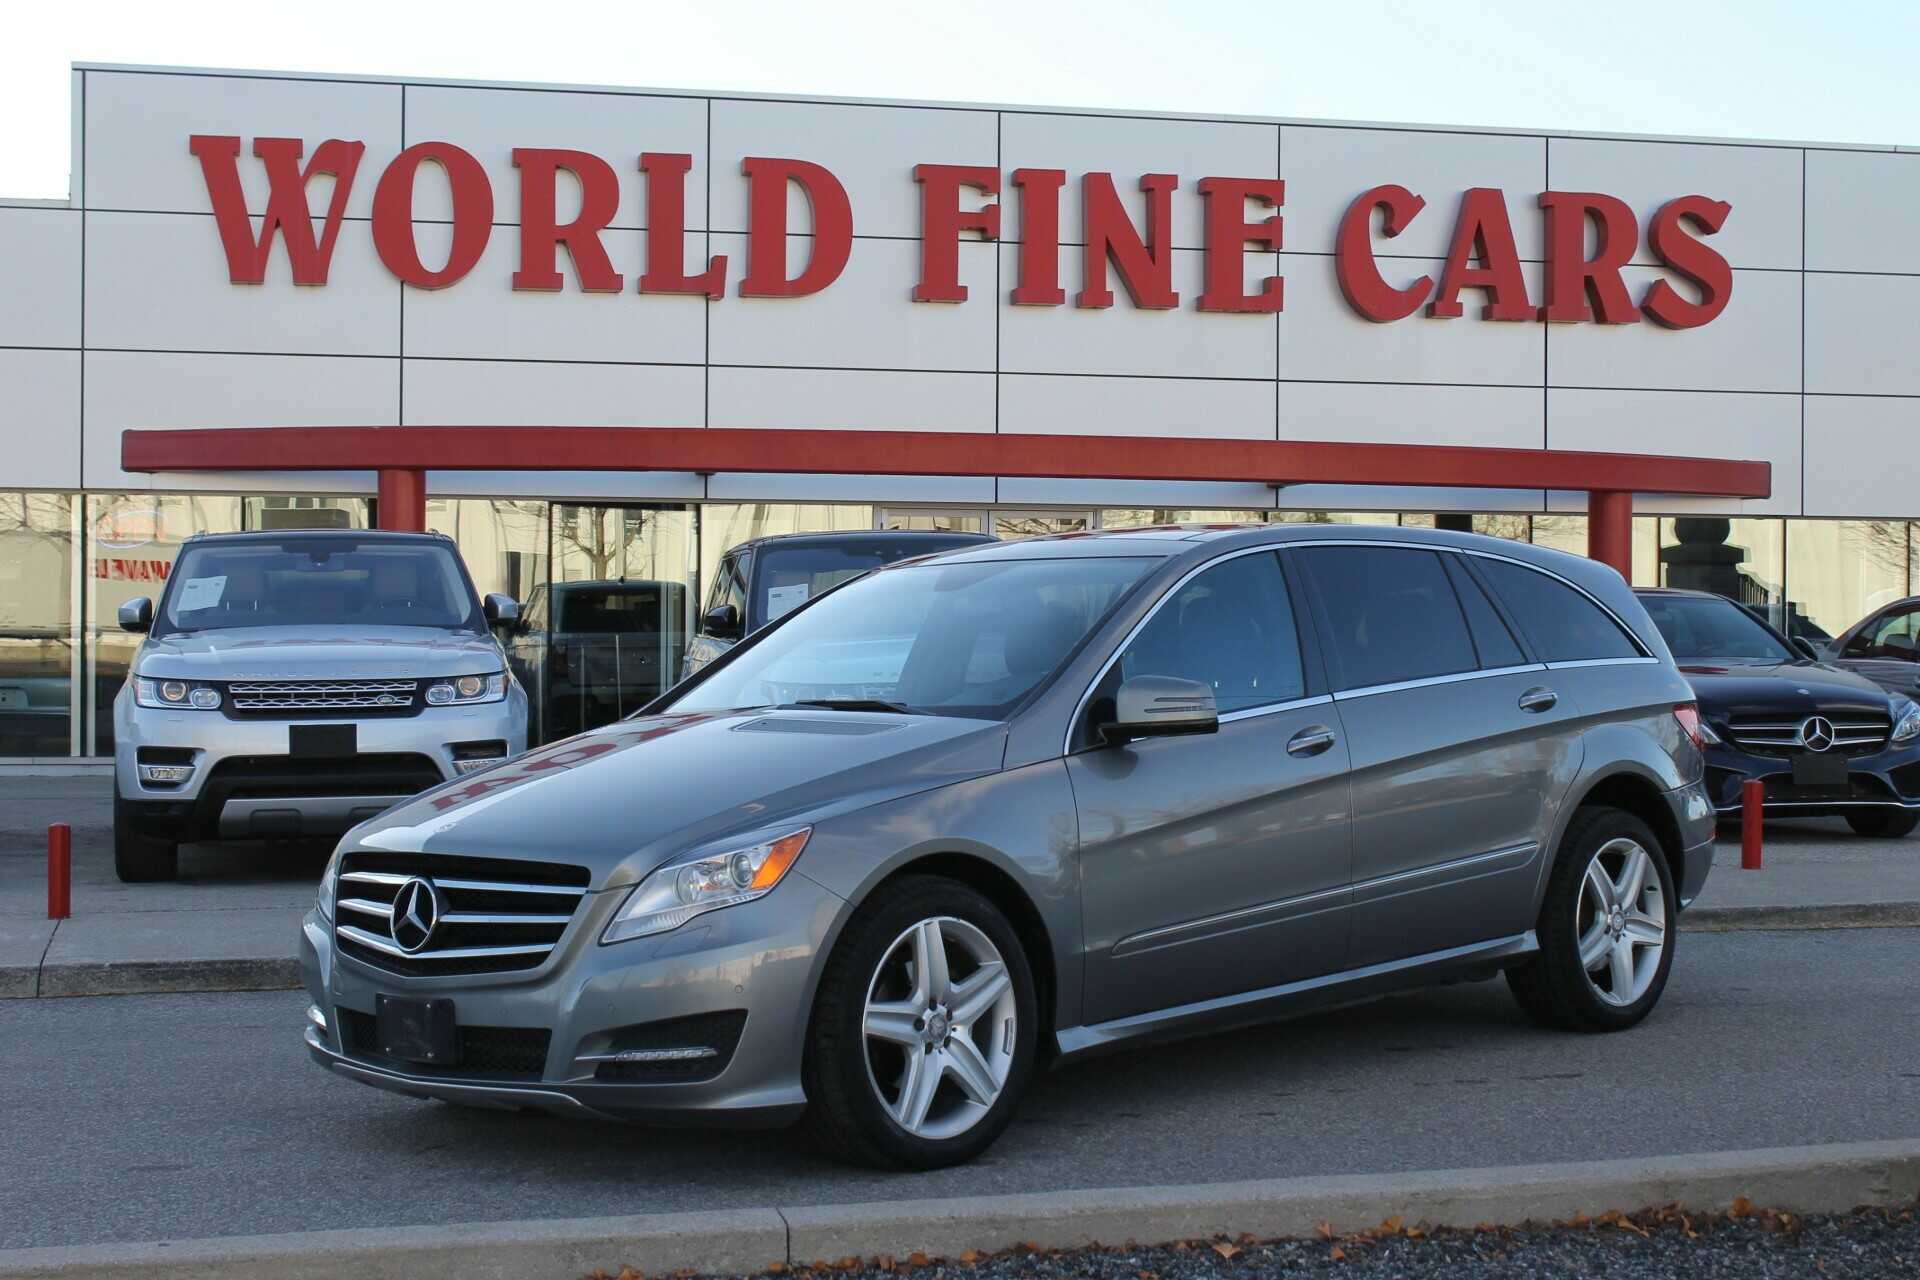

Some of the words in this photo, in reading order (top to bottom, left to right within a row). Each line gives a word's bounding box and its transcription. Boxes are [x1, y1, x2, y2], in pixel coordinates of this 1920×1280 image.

[189, 134, 853, 298] WORLD
[914, 164, 1286, 314] FINE
[1337, 184, 1733, 328] CARS
